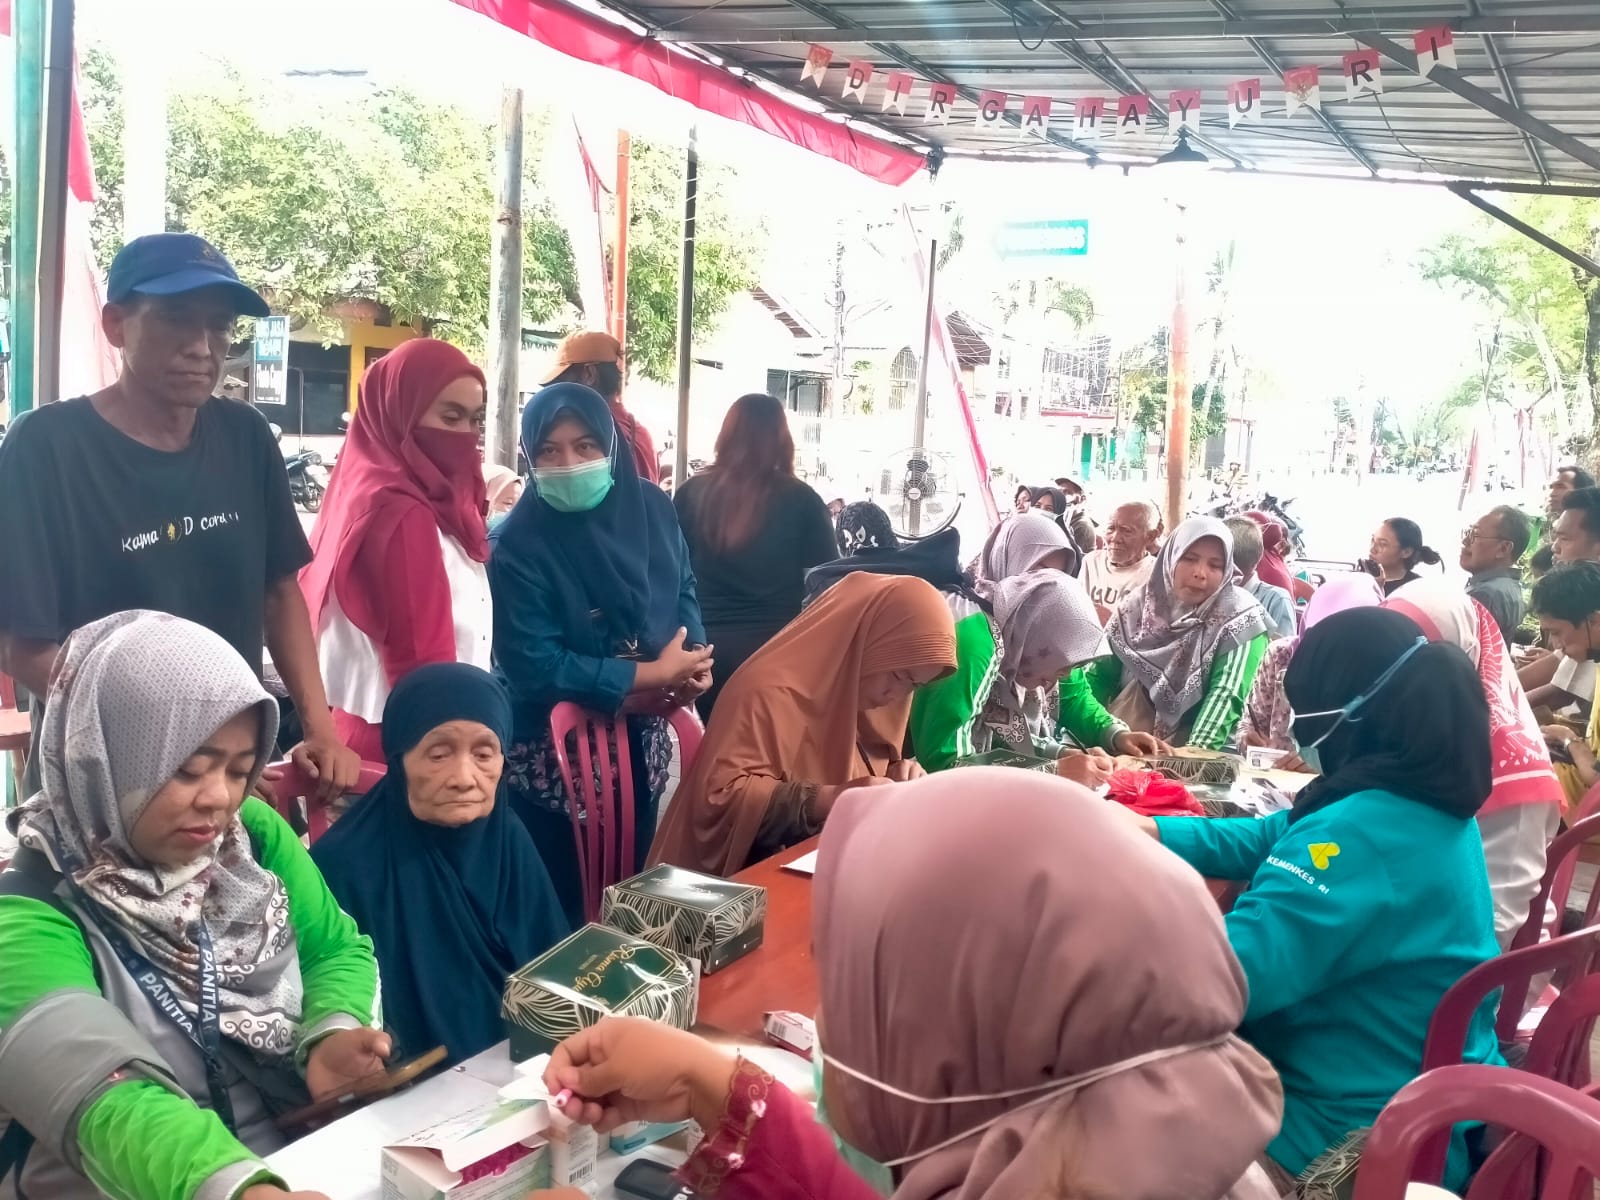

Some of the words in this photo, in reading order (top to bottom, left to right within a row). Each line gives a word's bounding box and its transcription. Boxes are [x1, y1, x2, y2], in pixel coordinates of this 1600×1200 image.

[849, 67, 1252, 127] DIRGAHAYU
[1266, 854, 1316, 885] KEMENKES
[1318, 884, 1330, 895] RI
[140, 972, 193, 1032] PANITIA
[201, 948, 217, 1022] PANITIA
